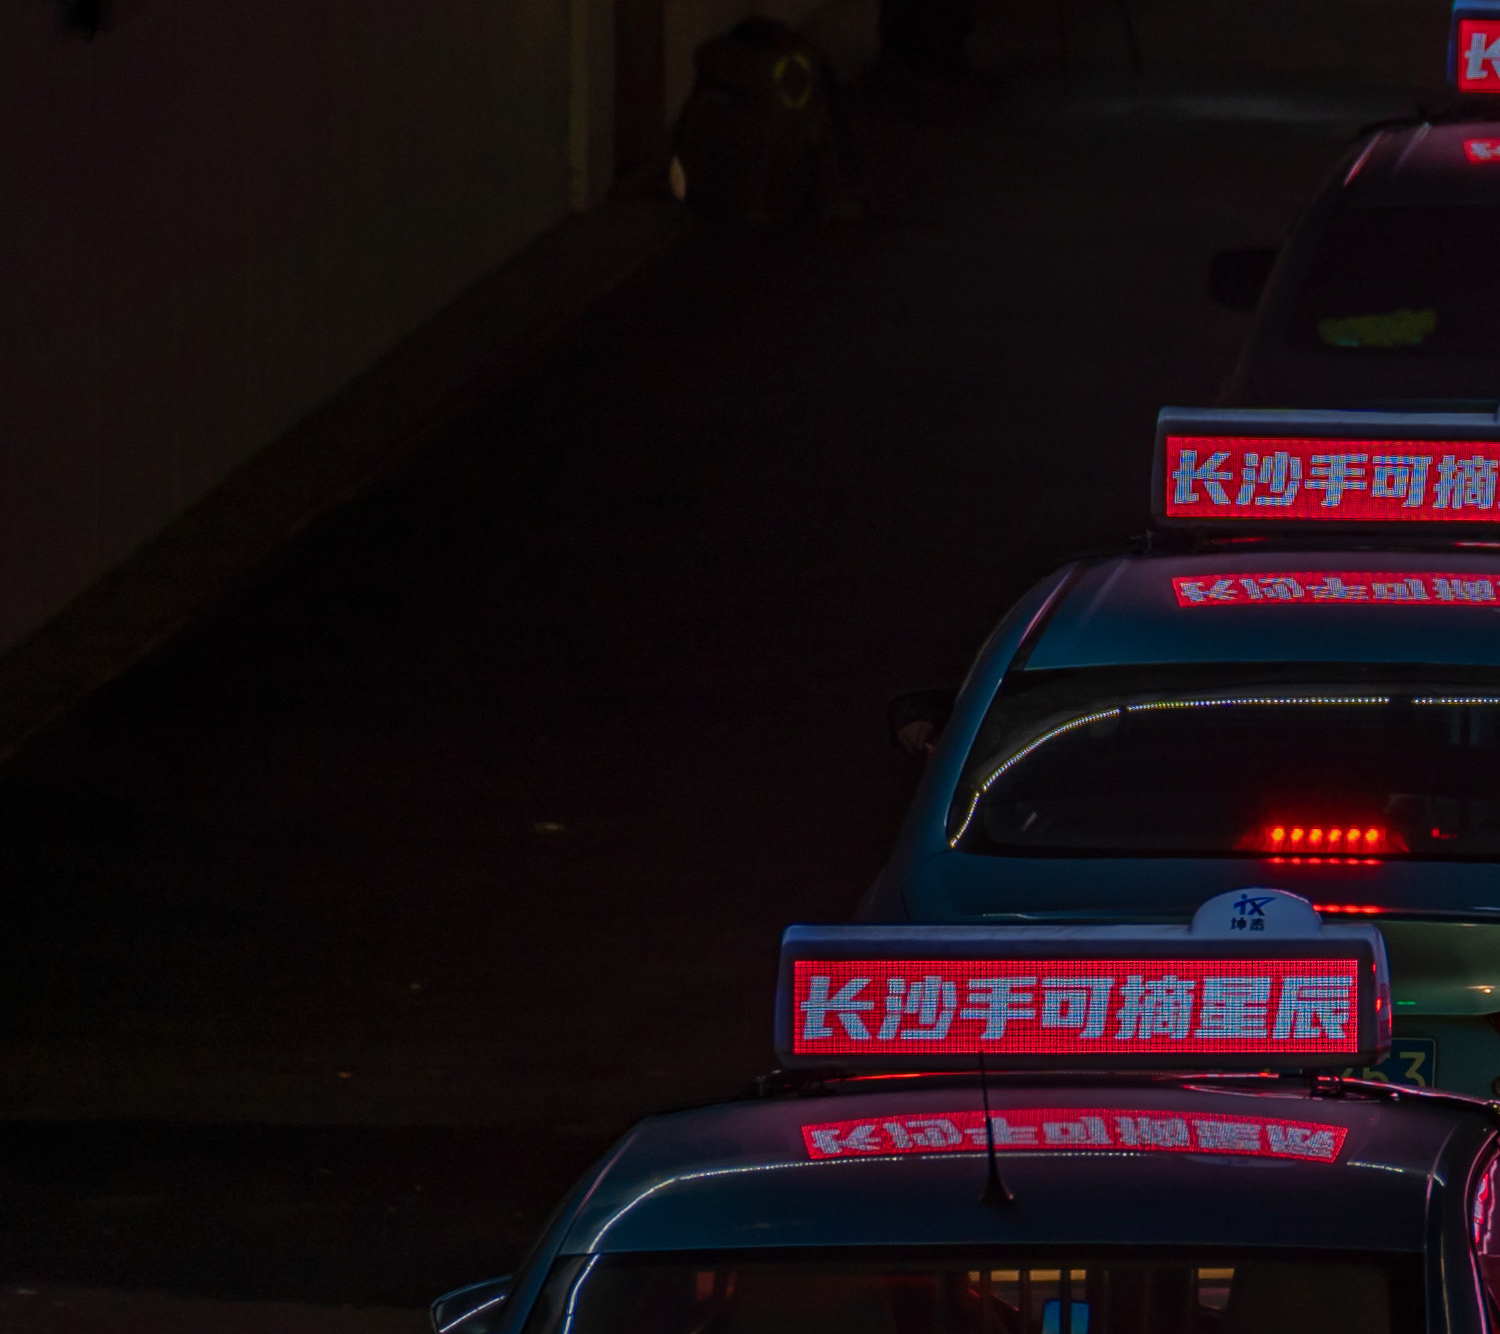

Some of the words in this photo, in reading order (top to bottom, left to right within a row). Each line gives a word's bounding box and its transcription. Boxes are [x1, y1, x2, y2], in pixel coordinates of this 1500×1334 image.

[802, 975, 1353, 1039] 长沙手可摘星辰
